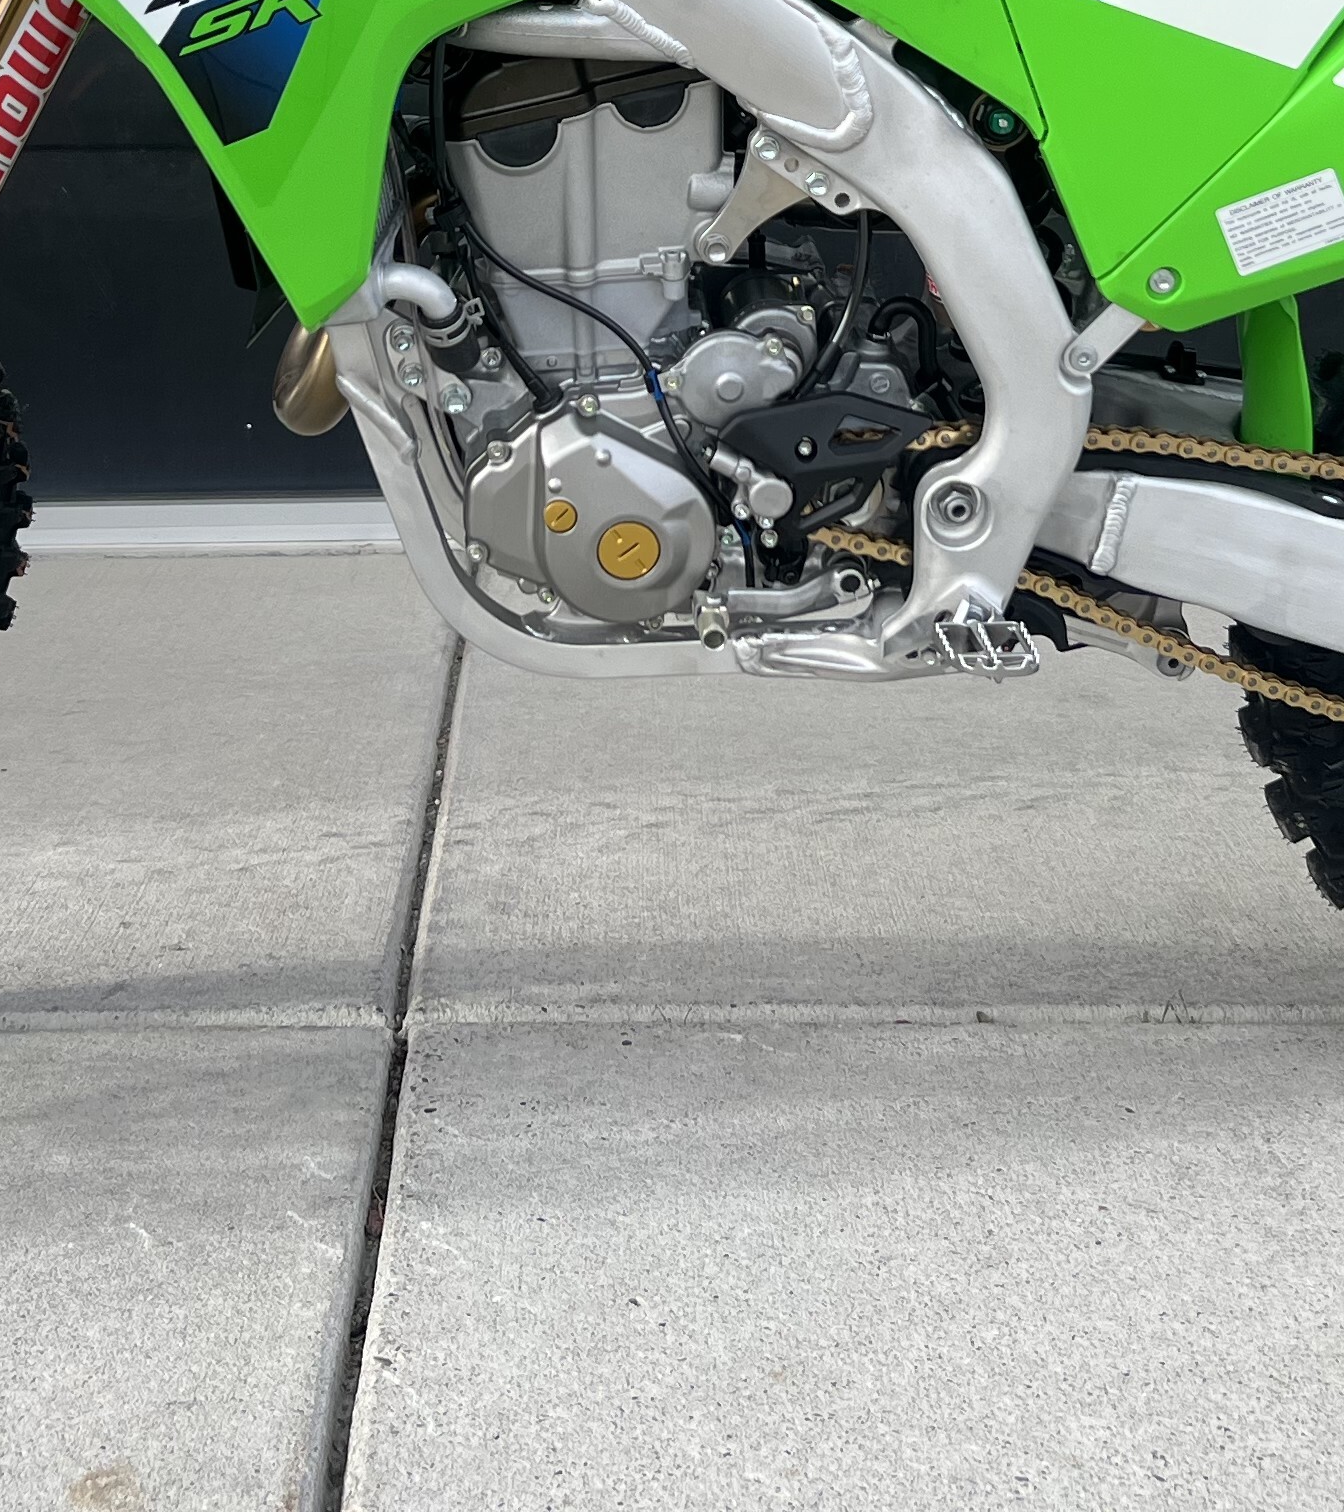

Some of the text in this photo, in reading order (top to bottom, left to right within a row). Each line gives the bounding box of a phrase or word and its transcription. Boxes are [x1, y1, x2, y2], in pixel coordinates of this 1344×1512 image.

[1229, 196, 1272, 216] DISCLAIMER
[1272, 191, 1283, 201] OF
[1284, 176, 1324, 196] WARRANTY
